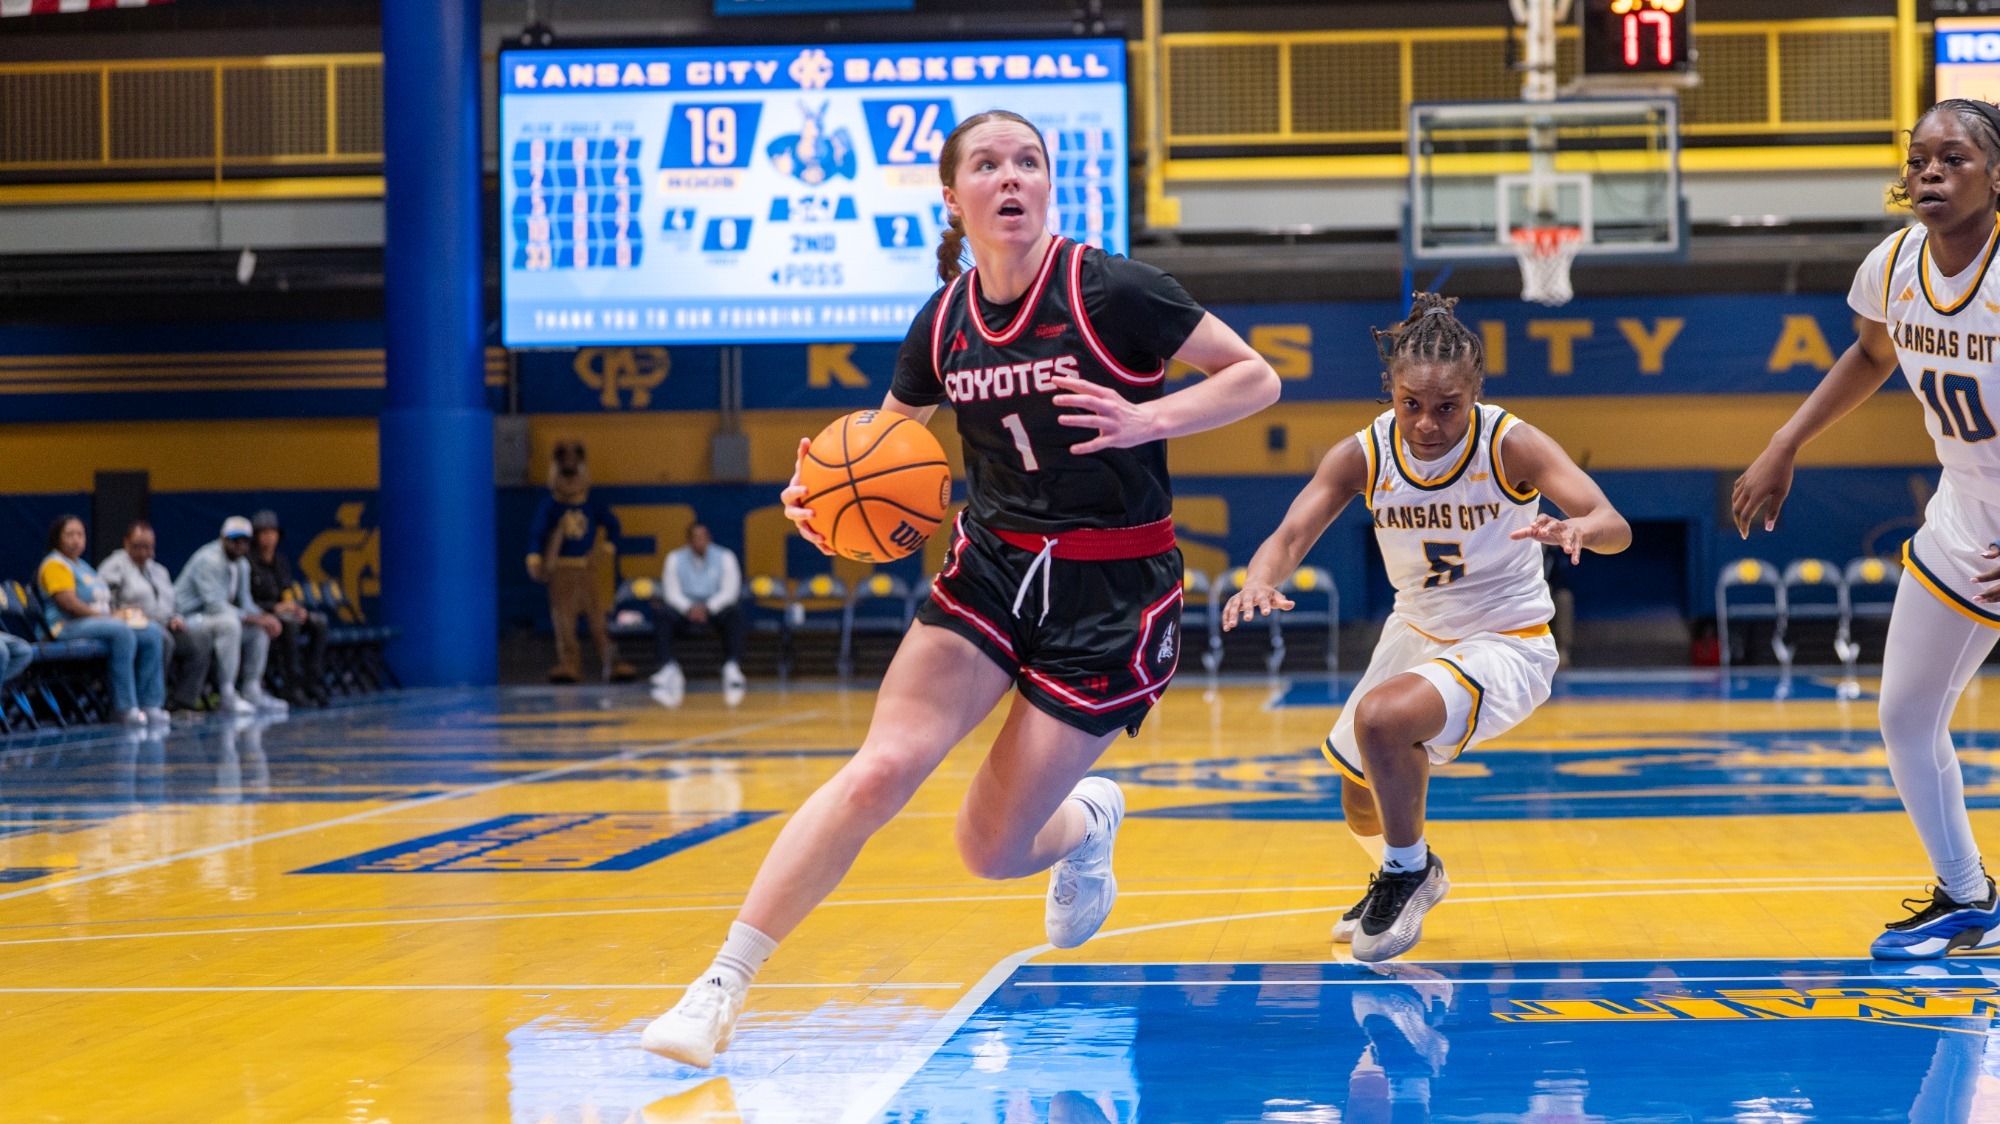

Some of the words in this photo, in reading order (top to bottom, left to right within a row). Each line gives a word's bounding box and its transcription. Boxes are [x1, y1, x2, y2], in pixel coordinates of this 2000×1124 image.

[1623, 10, 1672, 66] 17
[514, 62, 672, 89] KANSAS
[686, 60, 779, 85] CITY
[844, 54, 1109, 82] BASKETBALL
[686, 106, 737, 166] 19
[886, 103, 945, 164] 24
[790, 232, 837, 253] 2ND
[784, 263, 844, 287] POSS
[534, 309, 595, 330] THANK
[601, 309, 639, 330] YOU
[646, 308, 669, 329] TO
[675, 307, 713, 329] OUR
[1893, 320, 1959, 359] KANSAS
[1966, 332, 2000, 364] CIT
[1388, 318, 1685, 376] ITY
[945, 355, 1080, 402] COYOTES
[1919, 367, 1999, 444] 10
[1001, 413, 1039, 472] 1
[1373, 503, 1452, 530] KANSAS
[1458, 502, 1500, 532] CITY
[1421, 539, 1467, 590] 5
